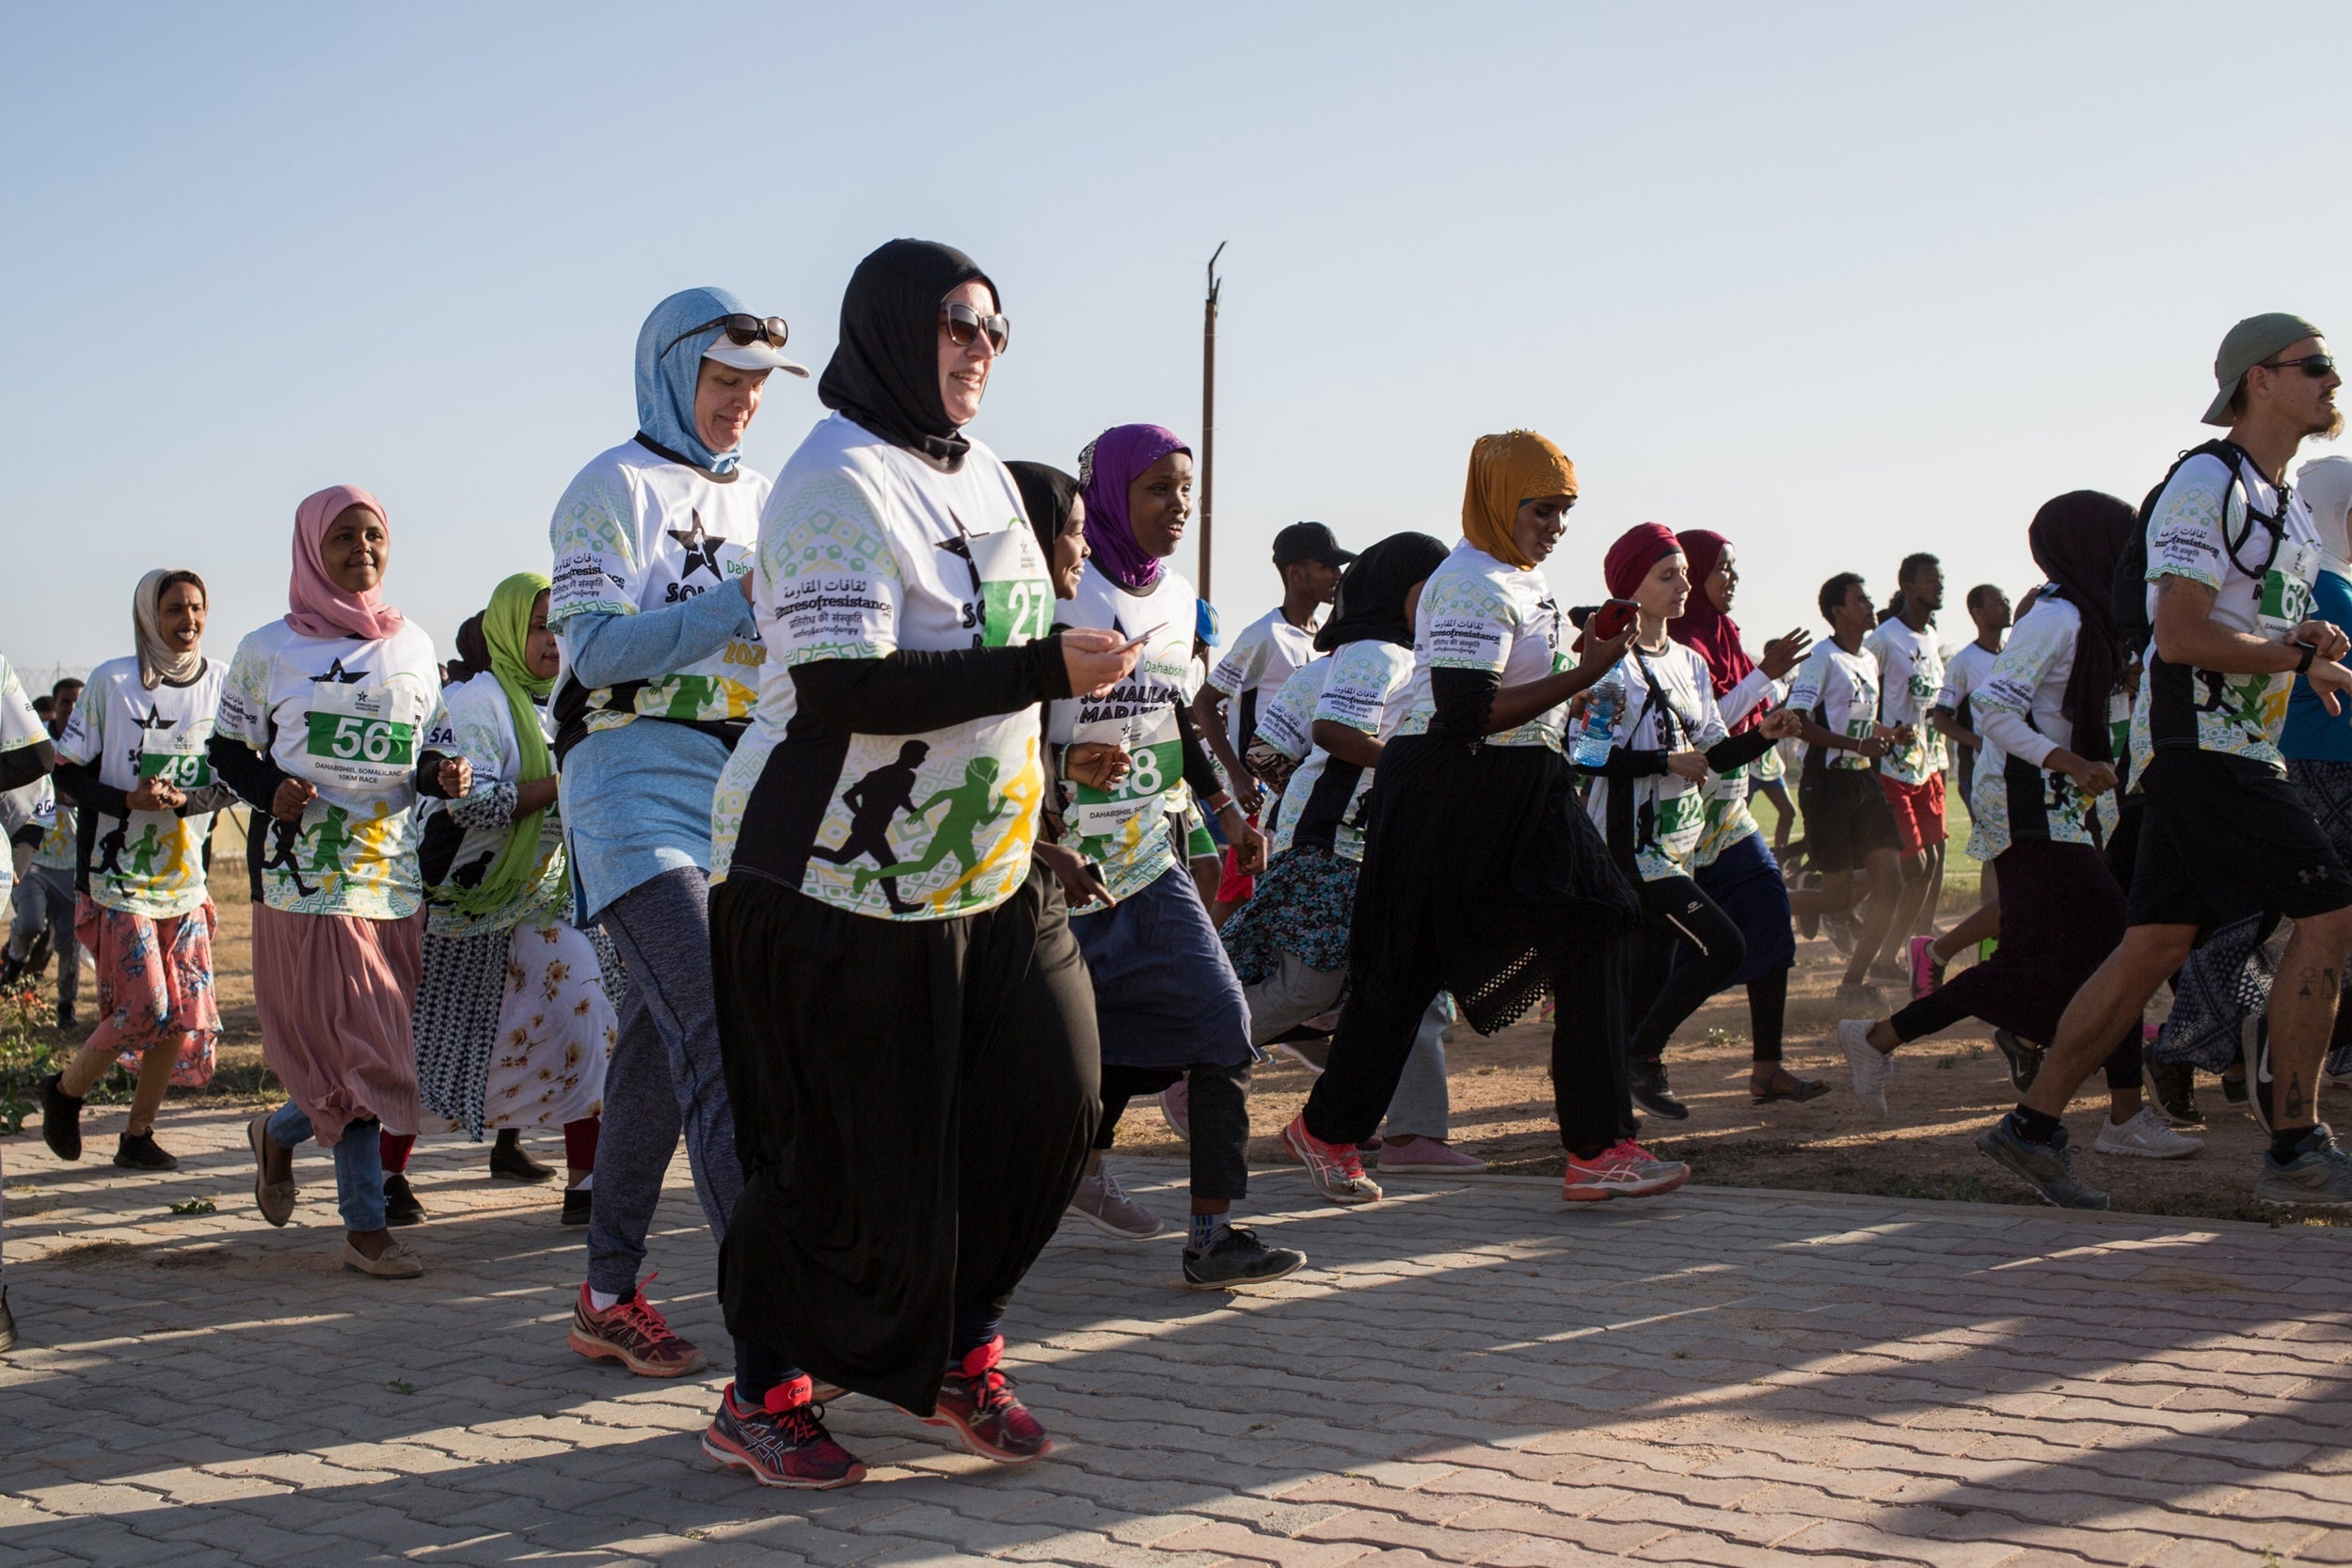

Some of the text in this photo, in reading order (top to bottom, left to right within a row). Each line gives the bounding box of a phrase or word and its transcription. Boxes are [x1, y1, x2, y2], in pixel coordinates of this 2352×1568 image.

[825, 579, 866, 593] ثقافات
[1006, 581, 1047, 646] 27
[331, 717, 391, 762] 56
[158, 755, 199, 786] 49
[315, 762, 403, 777] DAHABSHIIL SOMALILAND
[339, 773, 357, 782] 10KM
[1090, 808, 1132, 819] DAHABSHIIL
[1677, 796, 1702, 831] 22
